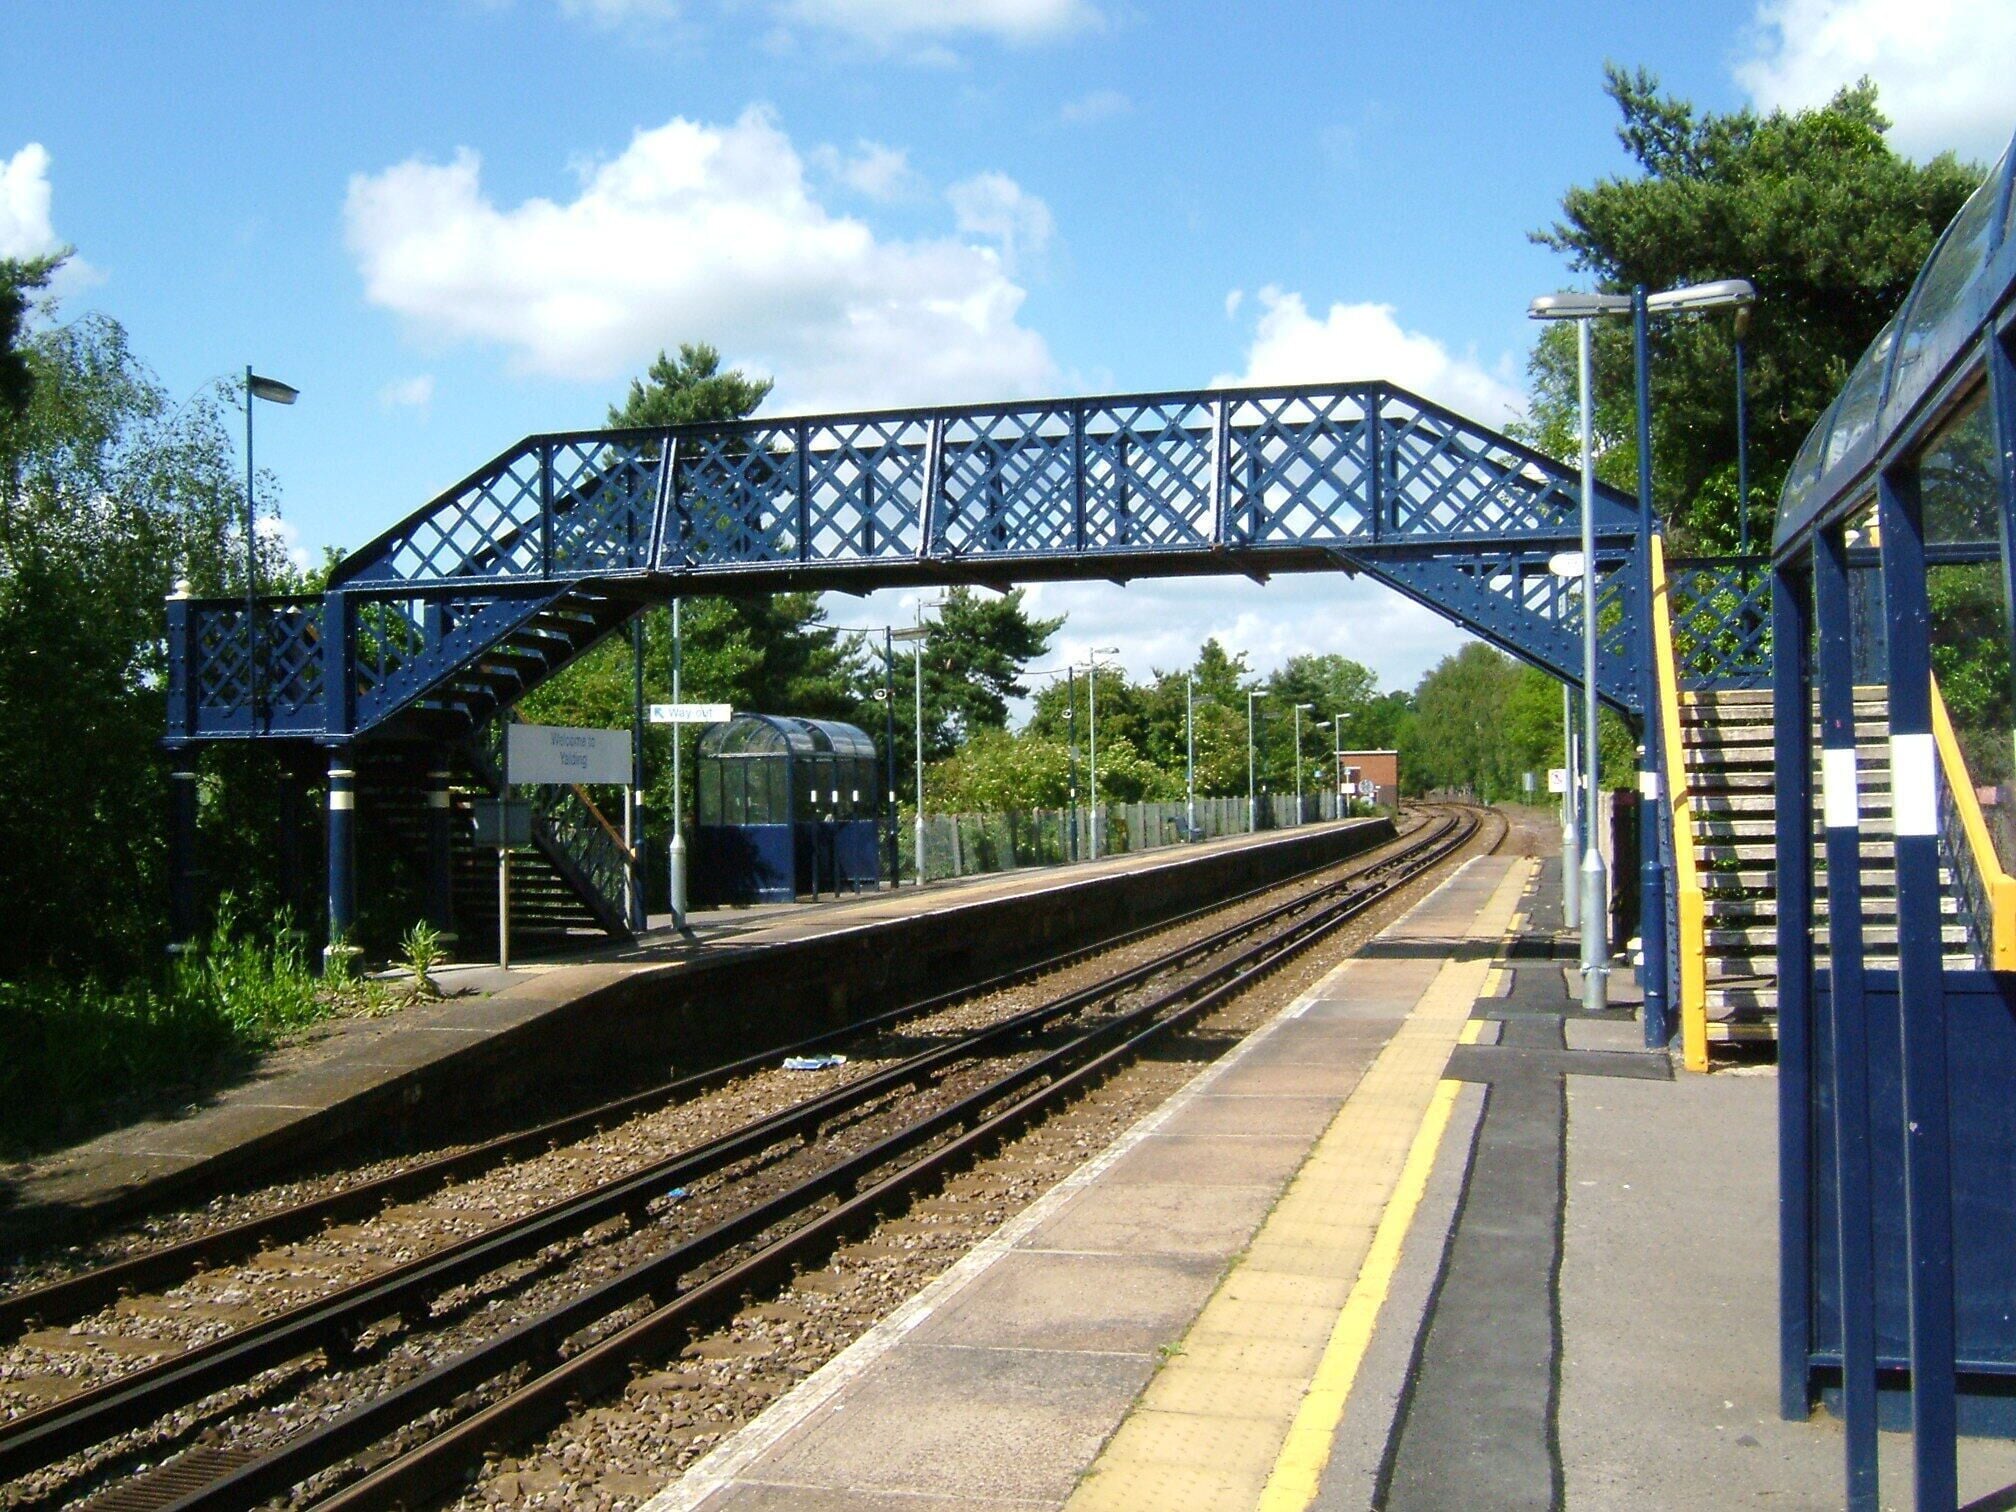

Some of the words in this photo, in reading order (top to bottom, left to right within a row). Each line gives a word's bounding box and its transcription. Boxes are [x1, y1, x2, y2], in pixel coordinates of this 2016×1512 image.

[668, 706, 691, 719] Way
[696, 708, 712, 718] out
[551, 732, 586, 747] Welcome
[588, 736, 595, 747] to
